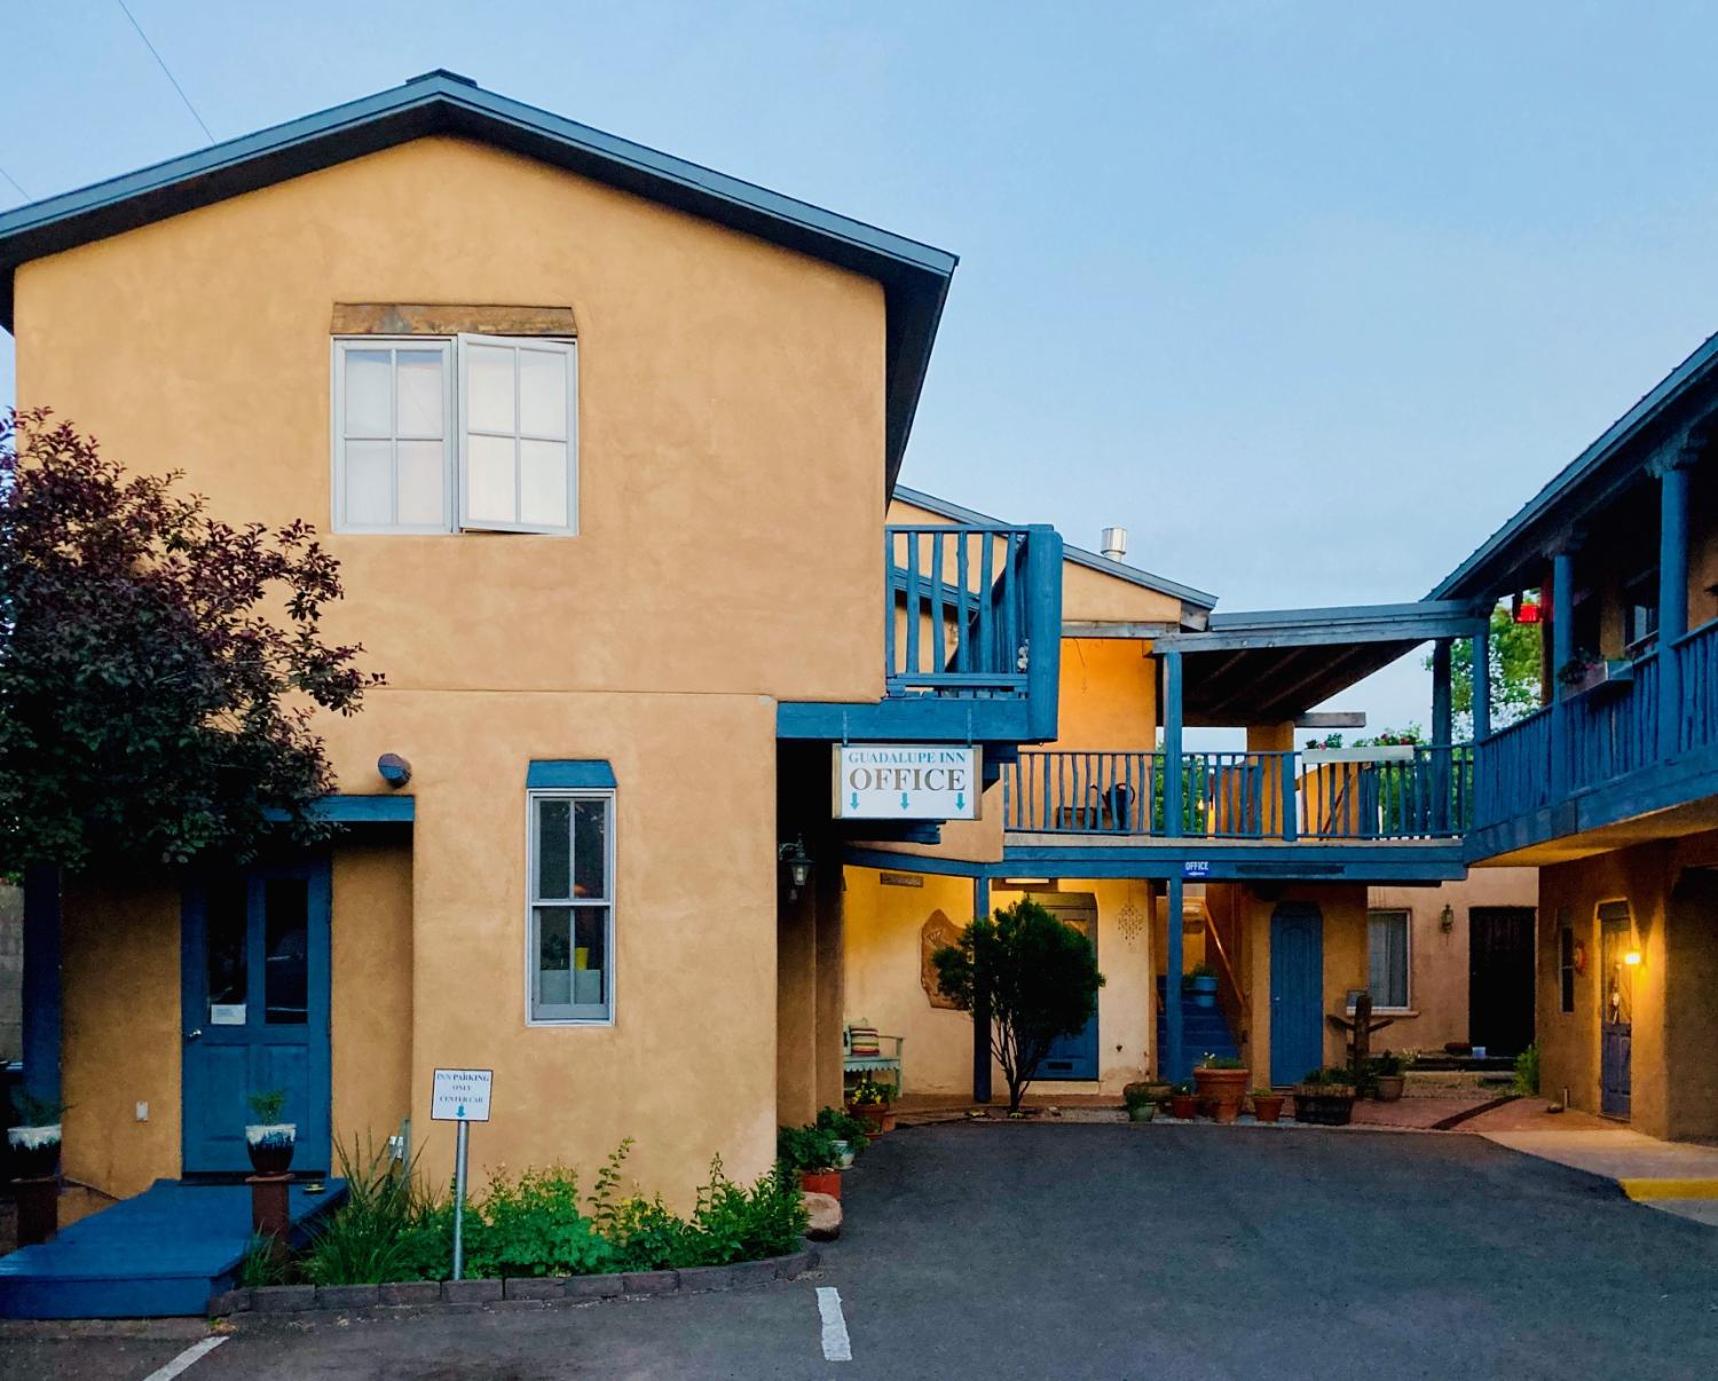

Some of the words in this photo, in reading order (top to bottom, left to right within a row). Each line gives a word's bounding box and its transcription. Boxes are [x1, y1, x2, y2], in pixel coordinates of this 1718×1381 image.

[848, 752, 936, 763] GUADALUPE
[940, 752, 966, 763] INN
[849, 767, 966, 791] OFFICE
[1185, 861, 1209, 870] OFFICE
[453, 1072, 489, 1082] PARKING
